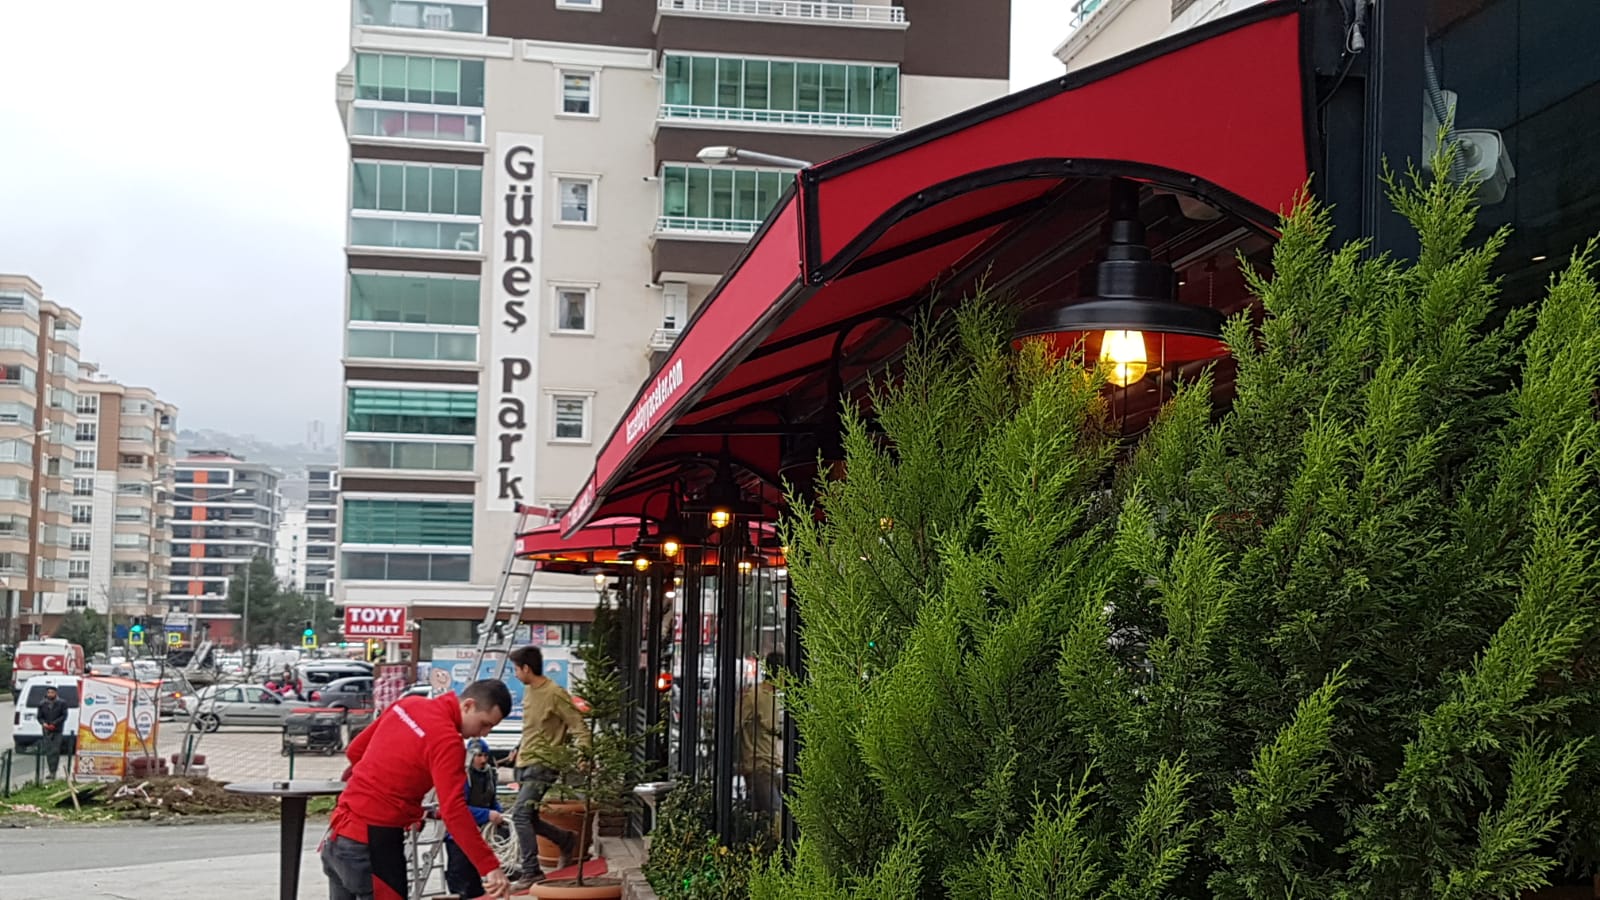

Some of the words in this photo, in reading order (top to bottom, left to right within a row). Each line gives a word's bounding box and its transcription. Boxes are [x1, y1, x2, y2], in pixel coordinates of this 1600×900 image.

[503, 145, 536, 333] Güneş
[348, 607, 402, 623] TOYY
[350, 625, 400, 634] MARKET
